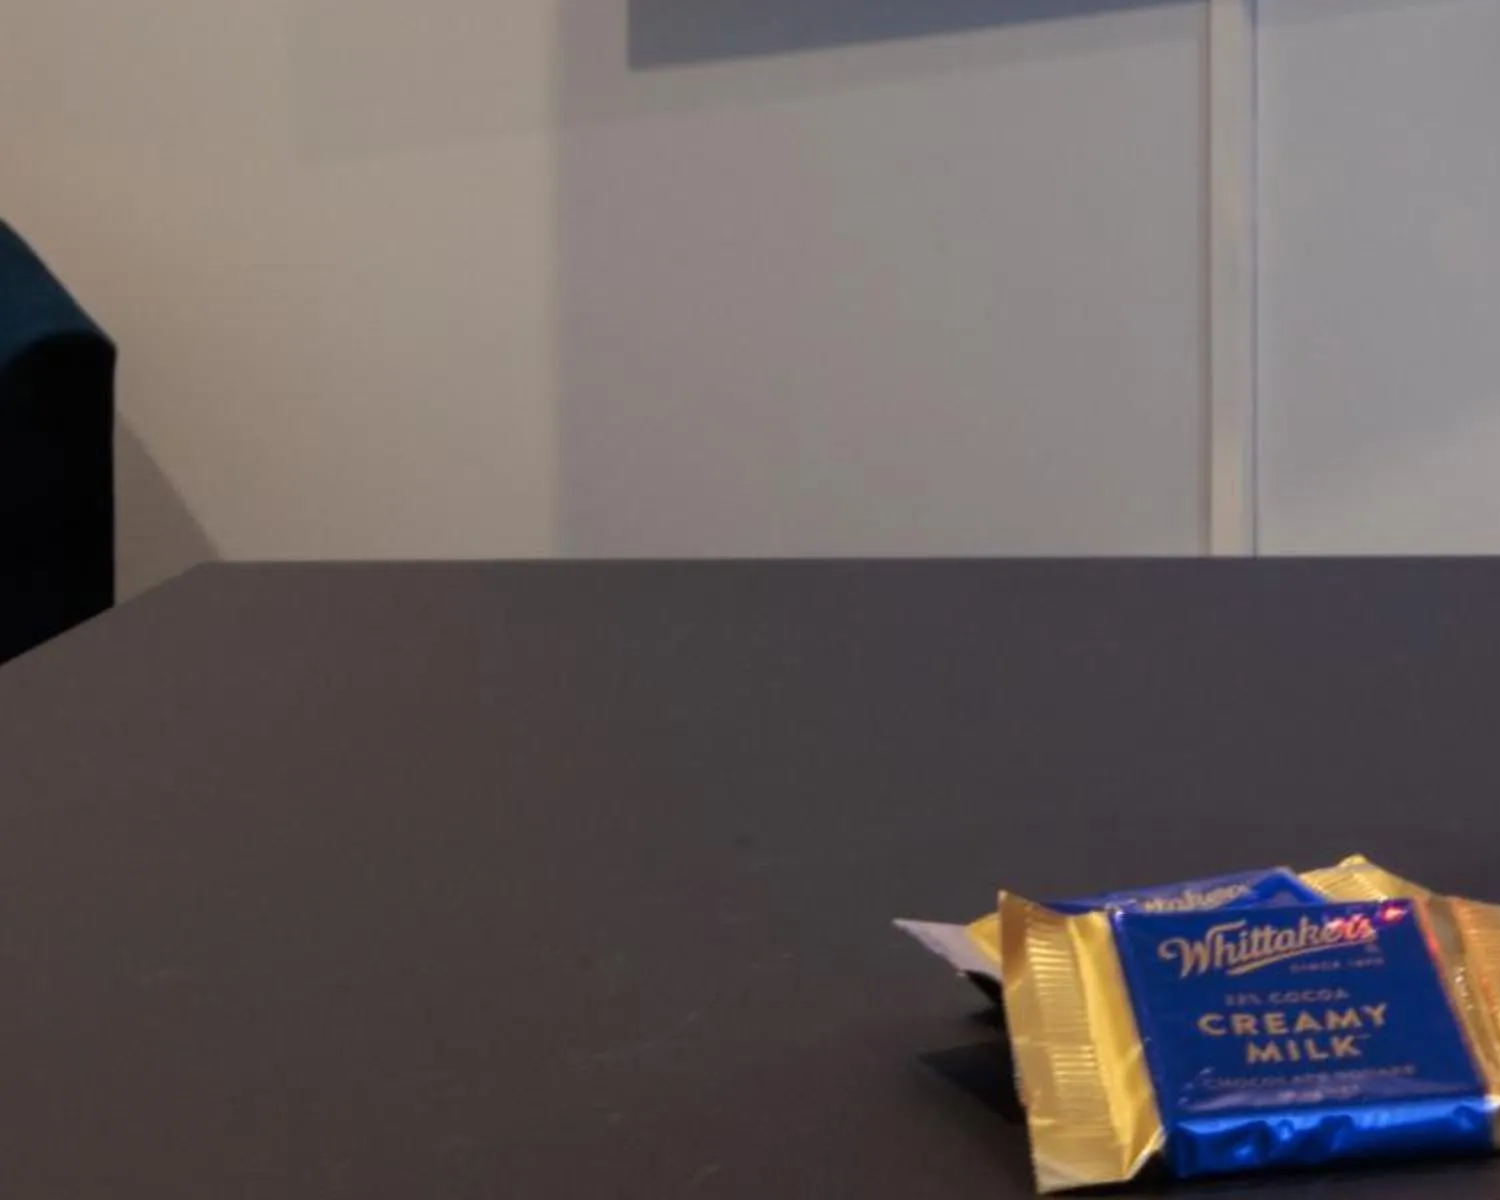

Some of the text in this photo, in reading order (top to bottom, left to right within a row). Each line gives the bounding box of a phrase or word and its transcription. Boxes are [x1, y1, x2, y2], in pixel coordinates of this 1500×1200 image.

[1268, 988, 1351, 1003] COCOA
[1197, 1003, 1388, 1035] CREAMY
[1246, 1036, 1362, 1063] MILK
